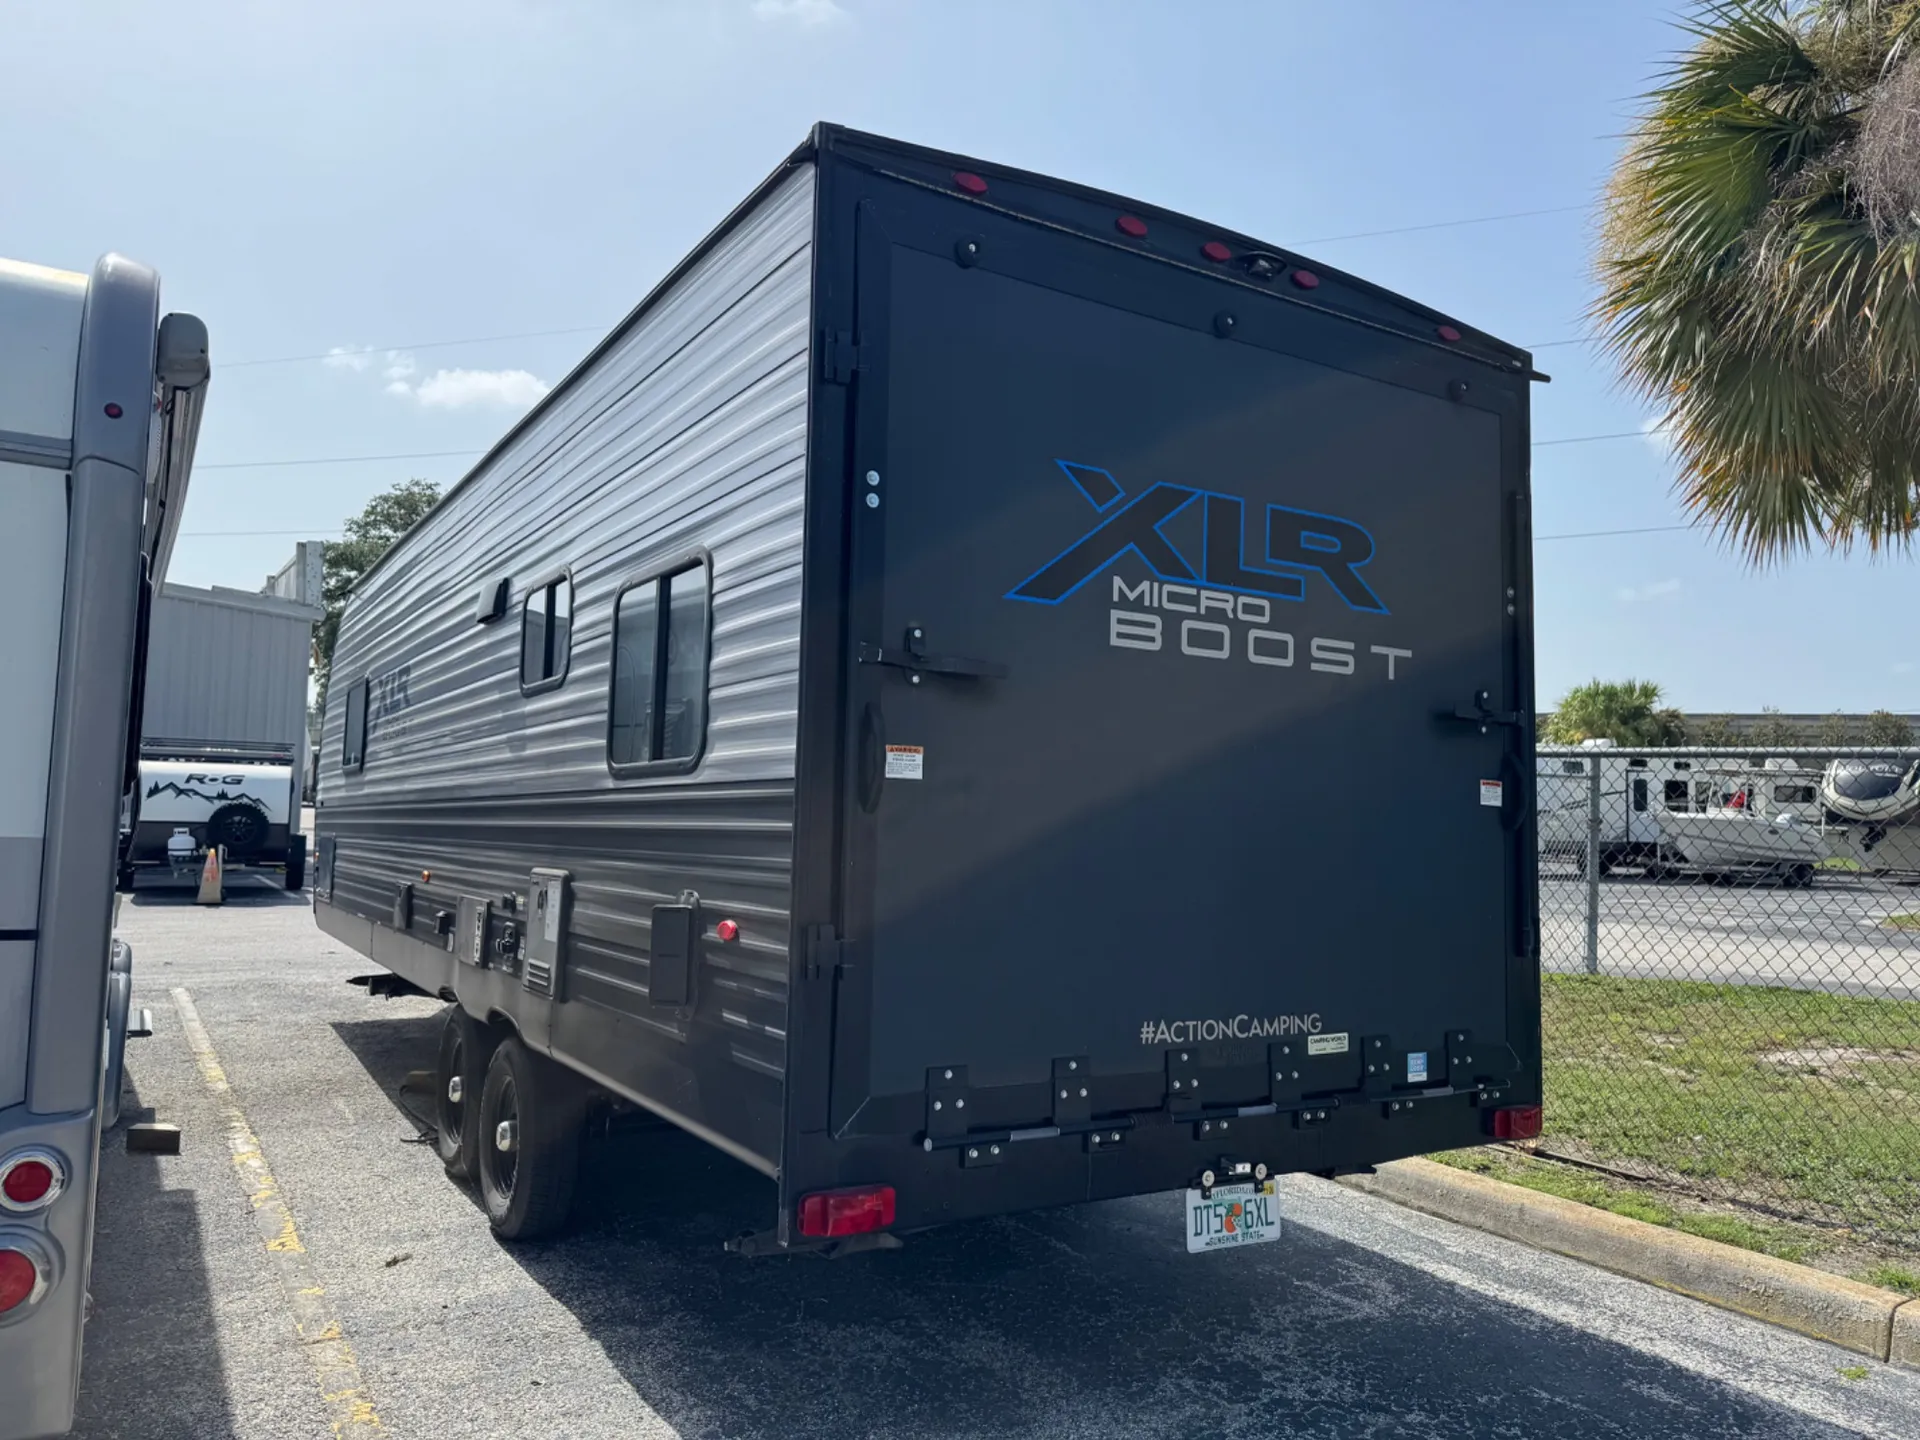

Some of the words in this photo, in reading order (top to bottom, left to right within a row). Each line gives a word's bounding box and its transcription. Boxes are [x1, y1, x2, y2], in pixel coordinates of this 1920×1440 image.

[1002, 458, 1391, 615] XLR
[1112, 575, 1270, 623] MICRO
[1109, 609, 1412, 680] BOOST
